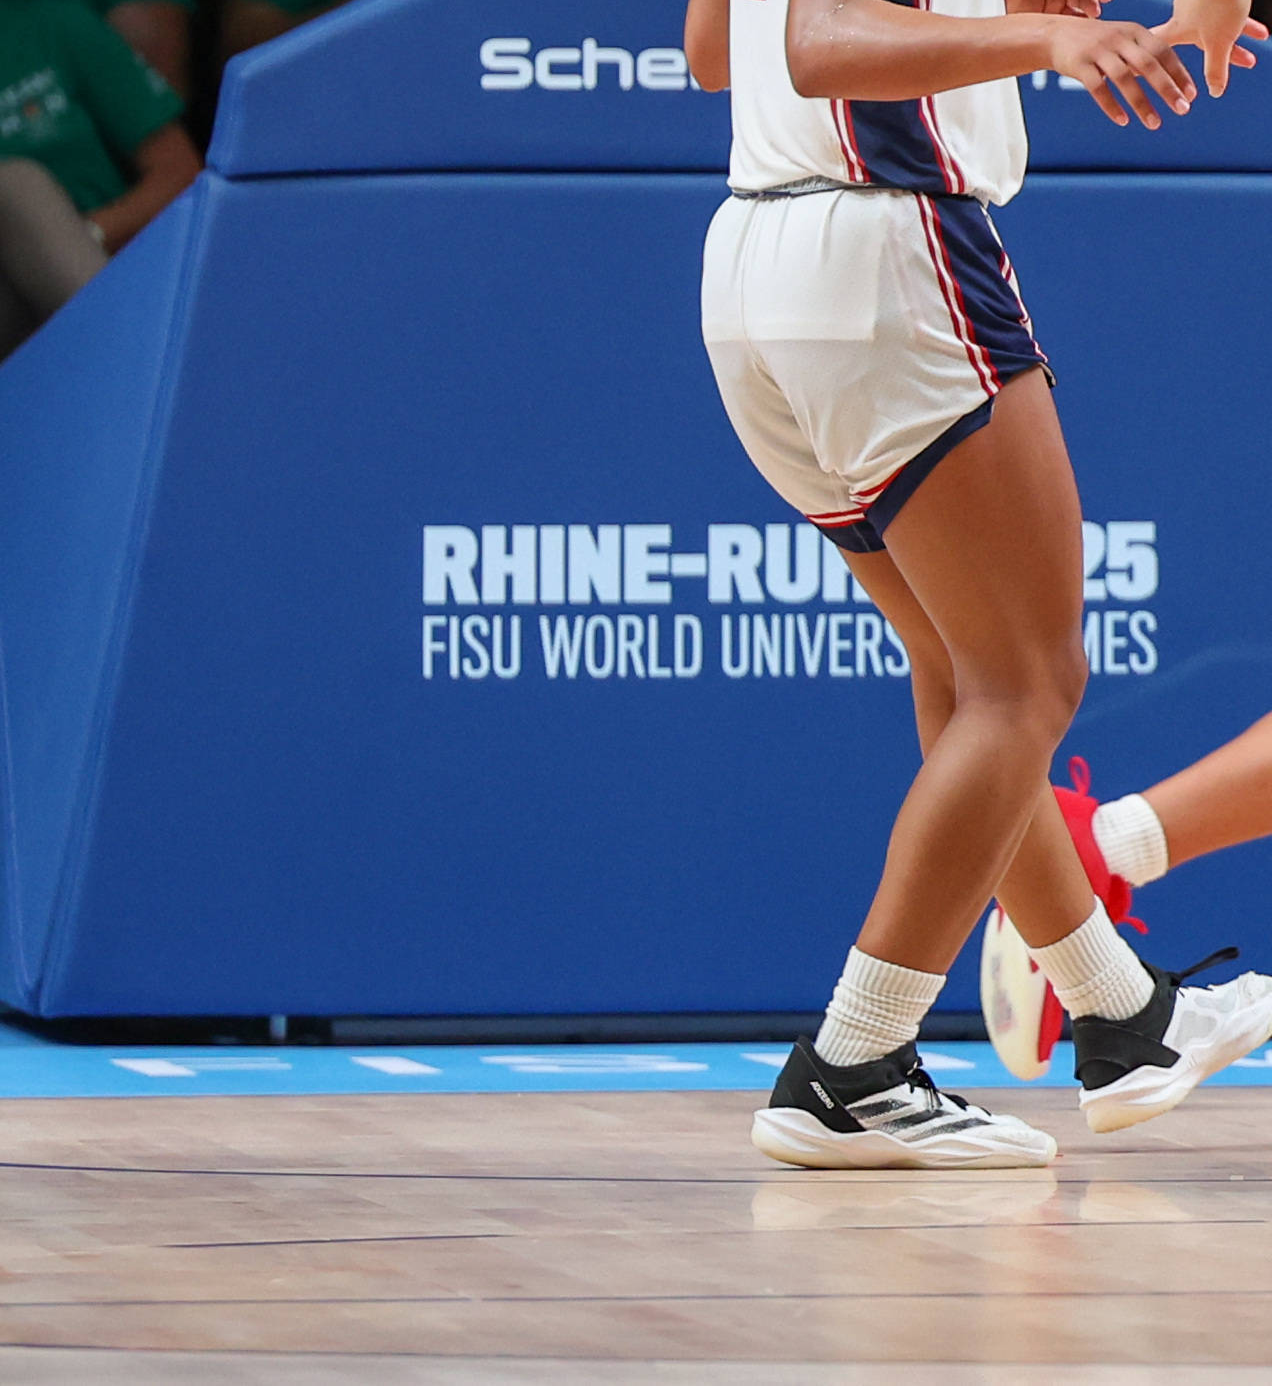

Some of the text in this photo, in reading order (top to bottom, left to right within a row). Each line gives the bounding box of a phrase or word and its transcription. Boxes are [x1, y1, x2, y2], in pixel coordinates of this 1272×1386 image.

[479, 37, 701, 91] Sche
[422, 614, 521, 680] FISU
[539, 614, 703, 679] WORLD
[721, 612, 910, 678] UNIVERS
